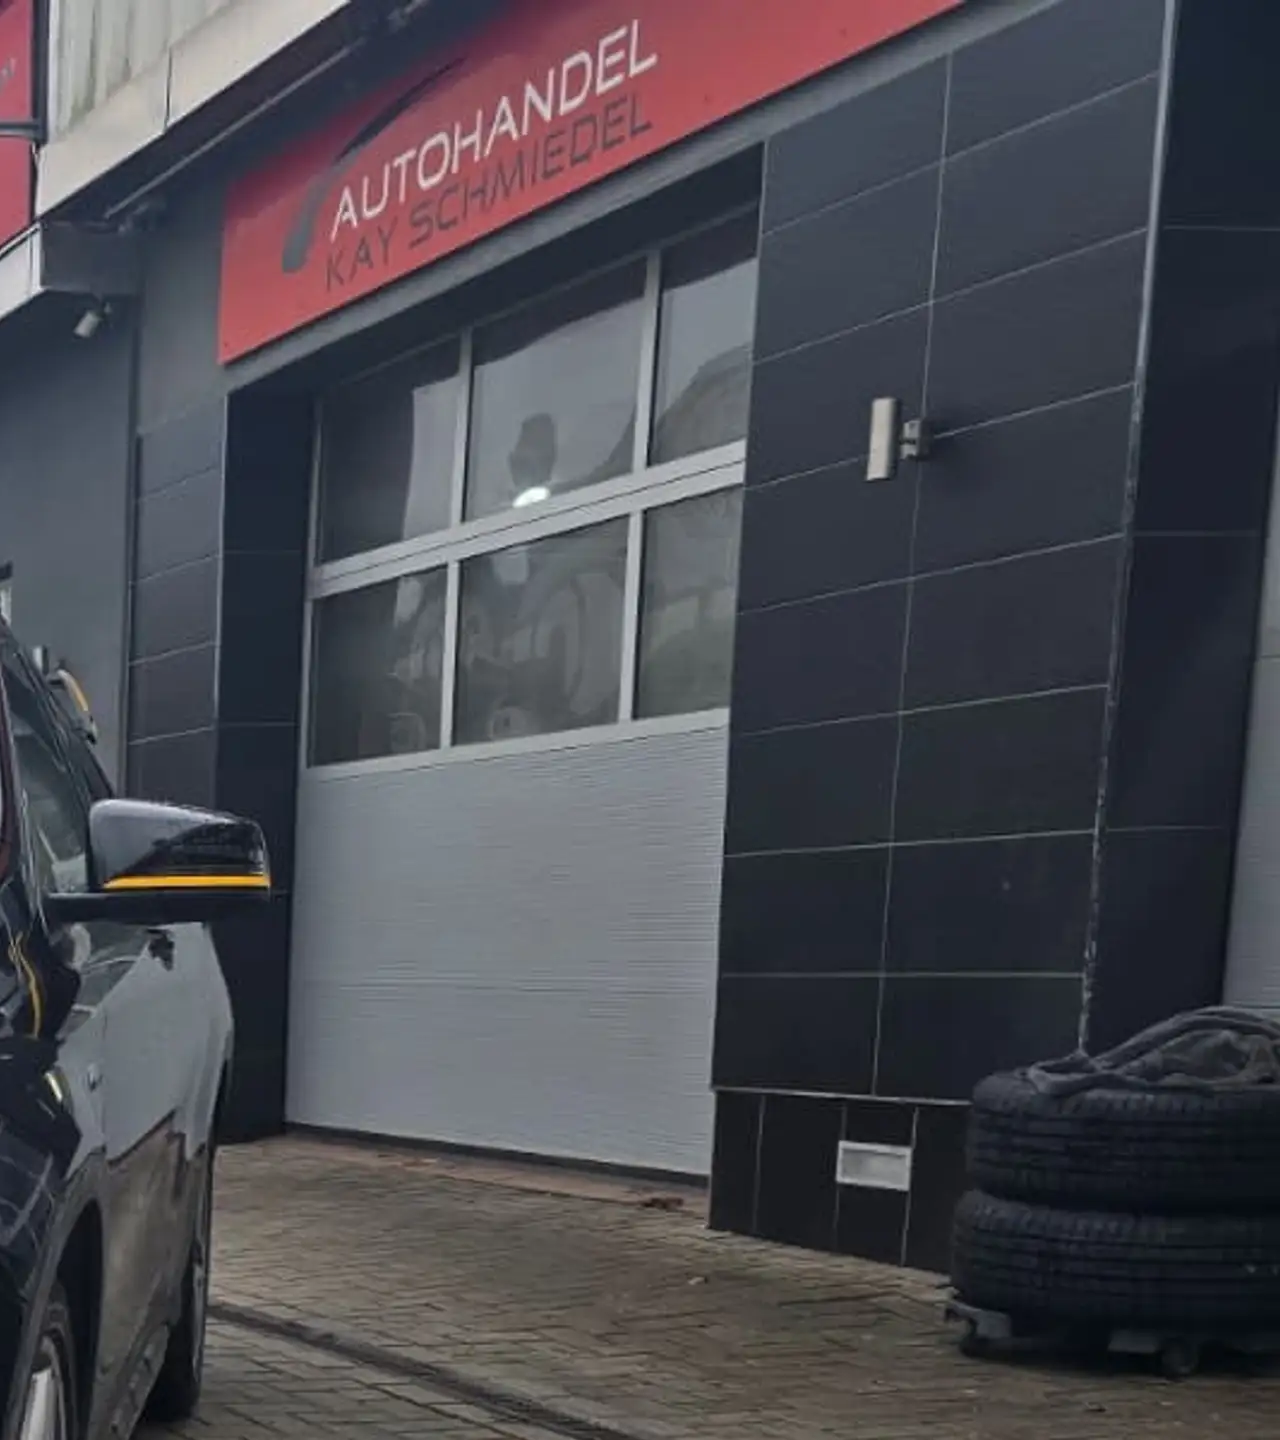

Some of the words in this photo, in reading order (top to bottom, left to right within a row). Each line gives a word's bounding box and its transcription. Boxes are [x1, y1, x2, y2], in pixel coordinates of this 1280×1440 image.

[325, 216, 398, 292] KAY
[407, 93, 653, 250] SCHMIEDEL
[330, 18, 658, 244] AUTOHANDEL
